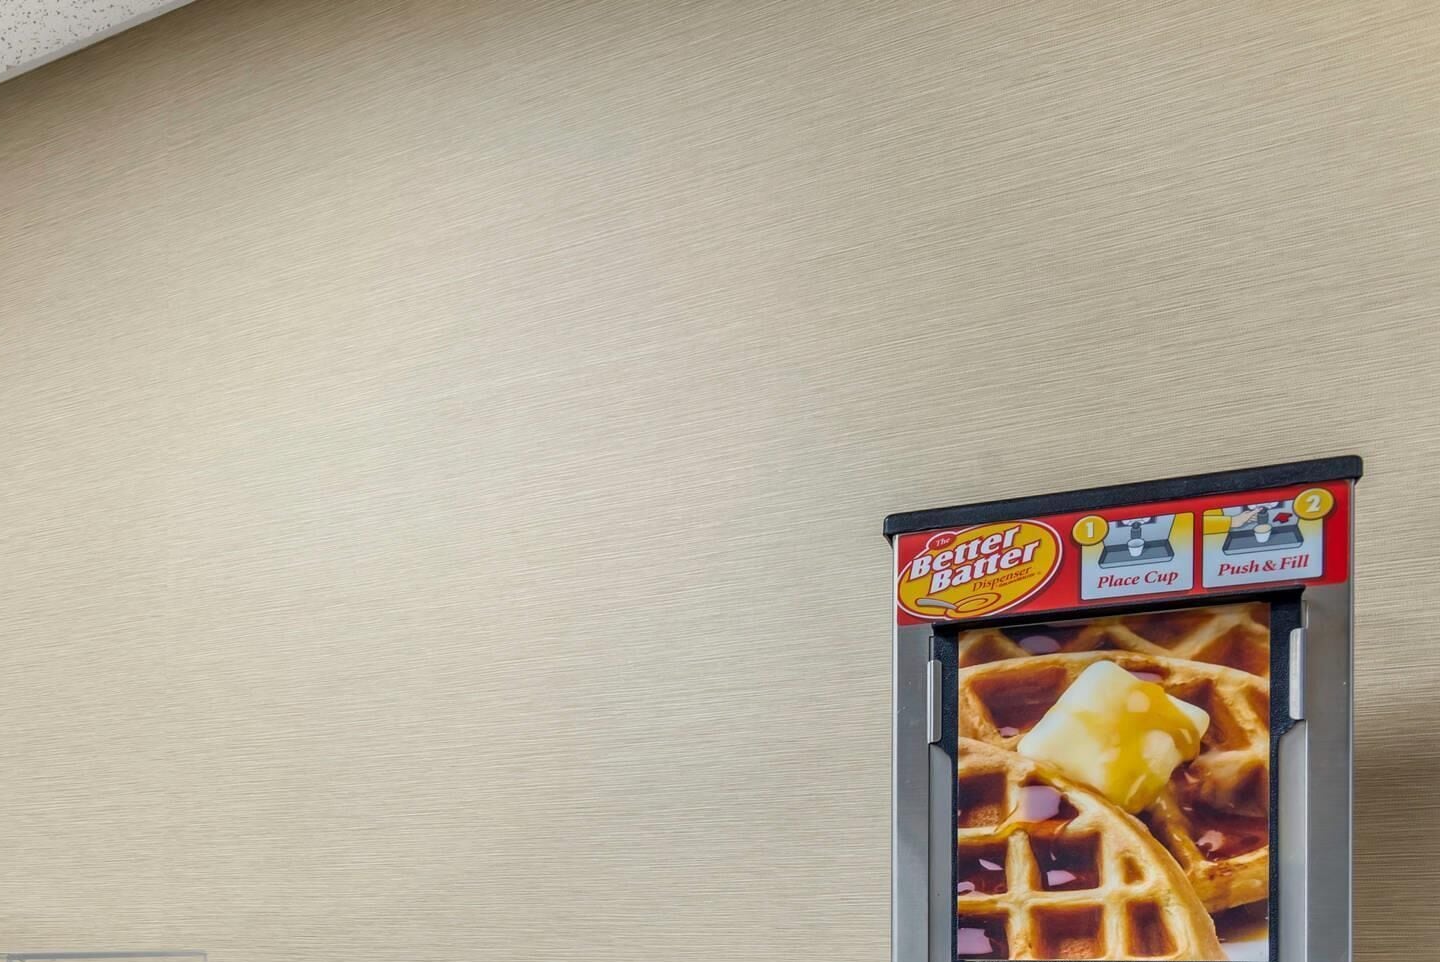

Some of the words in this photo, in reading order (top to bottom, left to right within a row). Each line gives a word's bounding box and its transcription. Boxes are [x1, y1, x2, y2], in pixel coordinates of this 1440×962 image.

[1305, 495, 1321, 513] 2
[1086, 522, 1094, 539] 1
[935, 537, 950, 547] The
[910, 525, 1022, 581] Better
[929, 541, 1041, 594] Batter
[1218, 560, 1260, 577] Push
[1262, 560, 1276, 572] &
[1279, 554, 1310, 569] Fill
[972, 566, 1033, 591] Dispenser
[1097, 572, 1140, 589] Place
[1144, 570, 1179, 585] Cup
